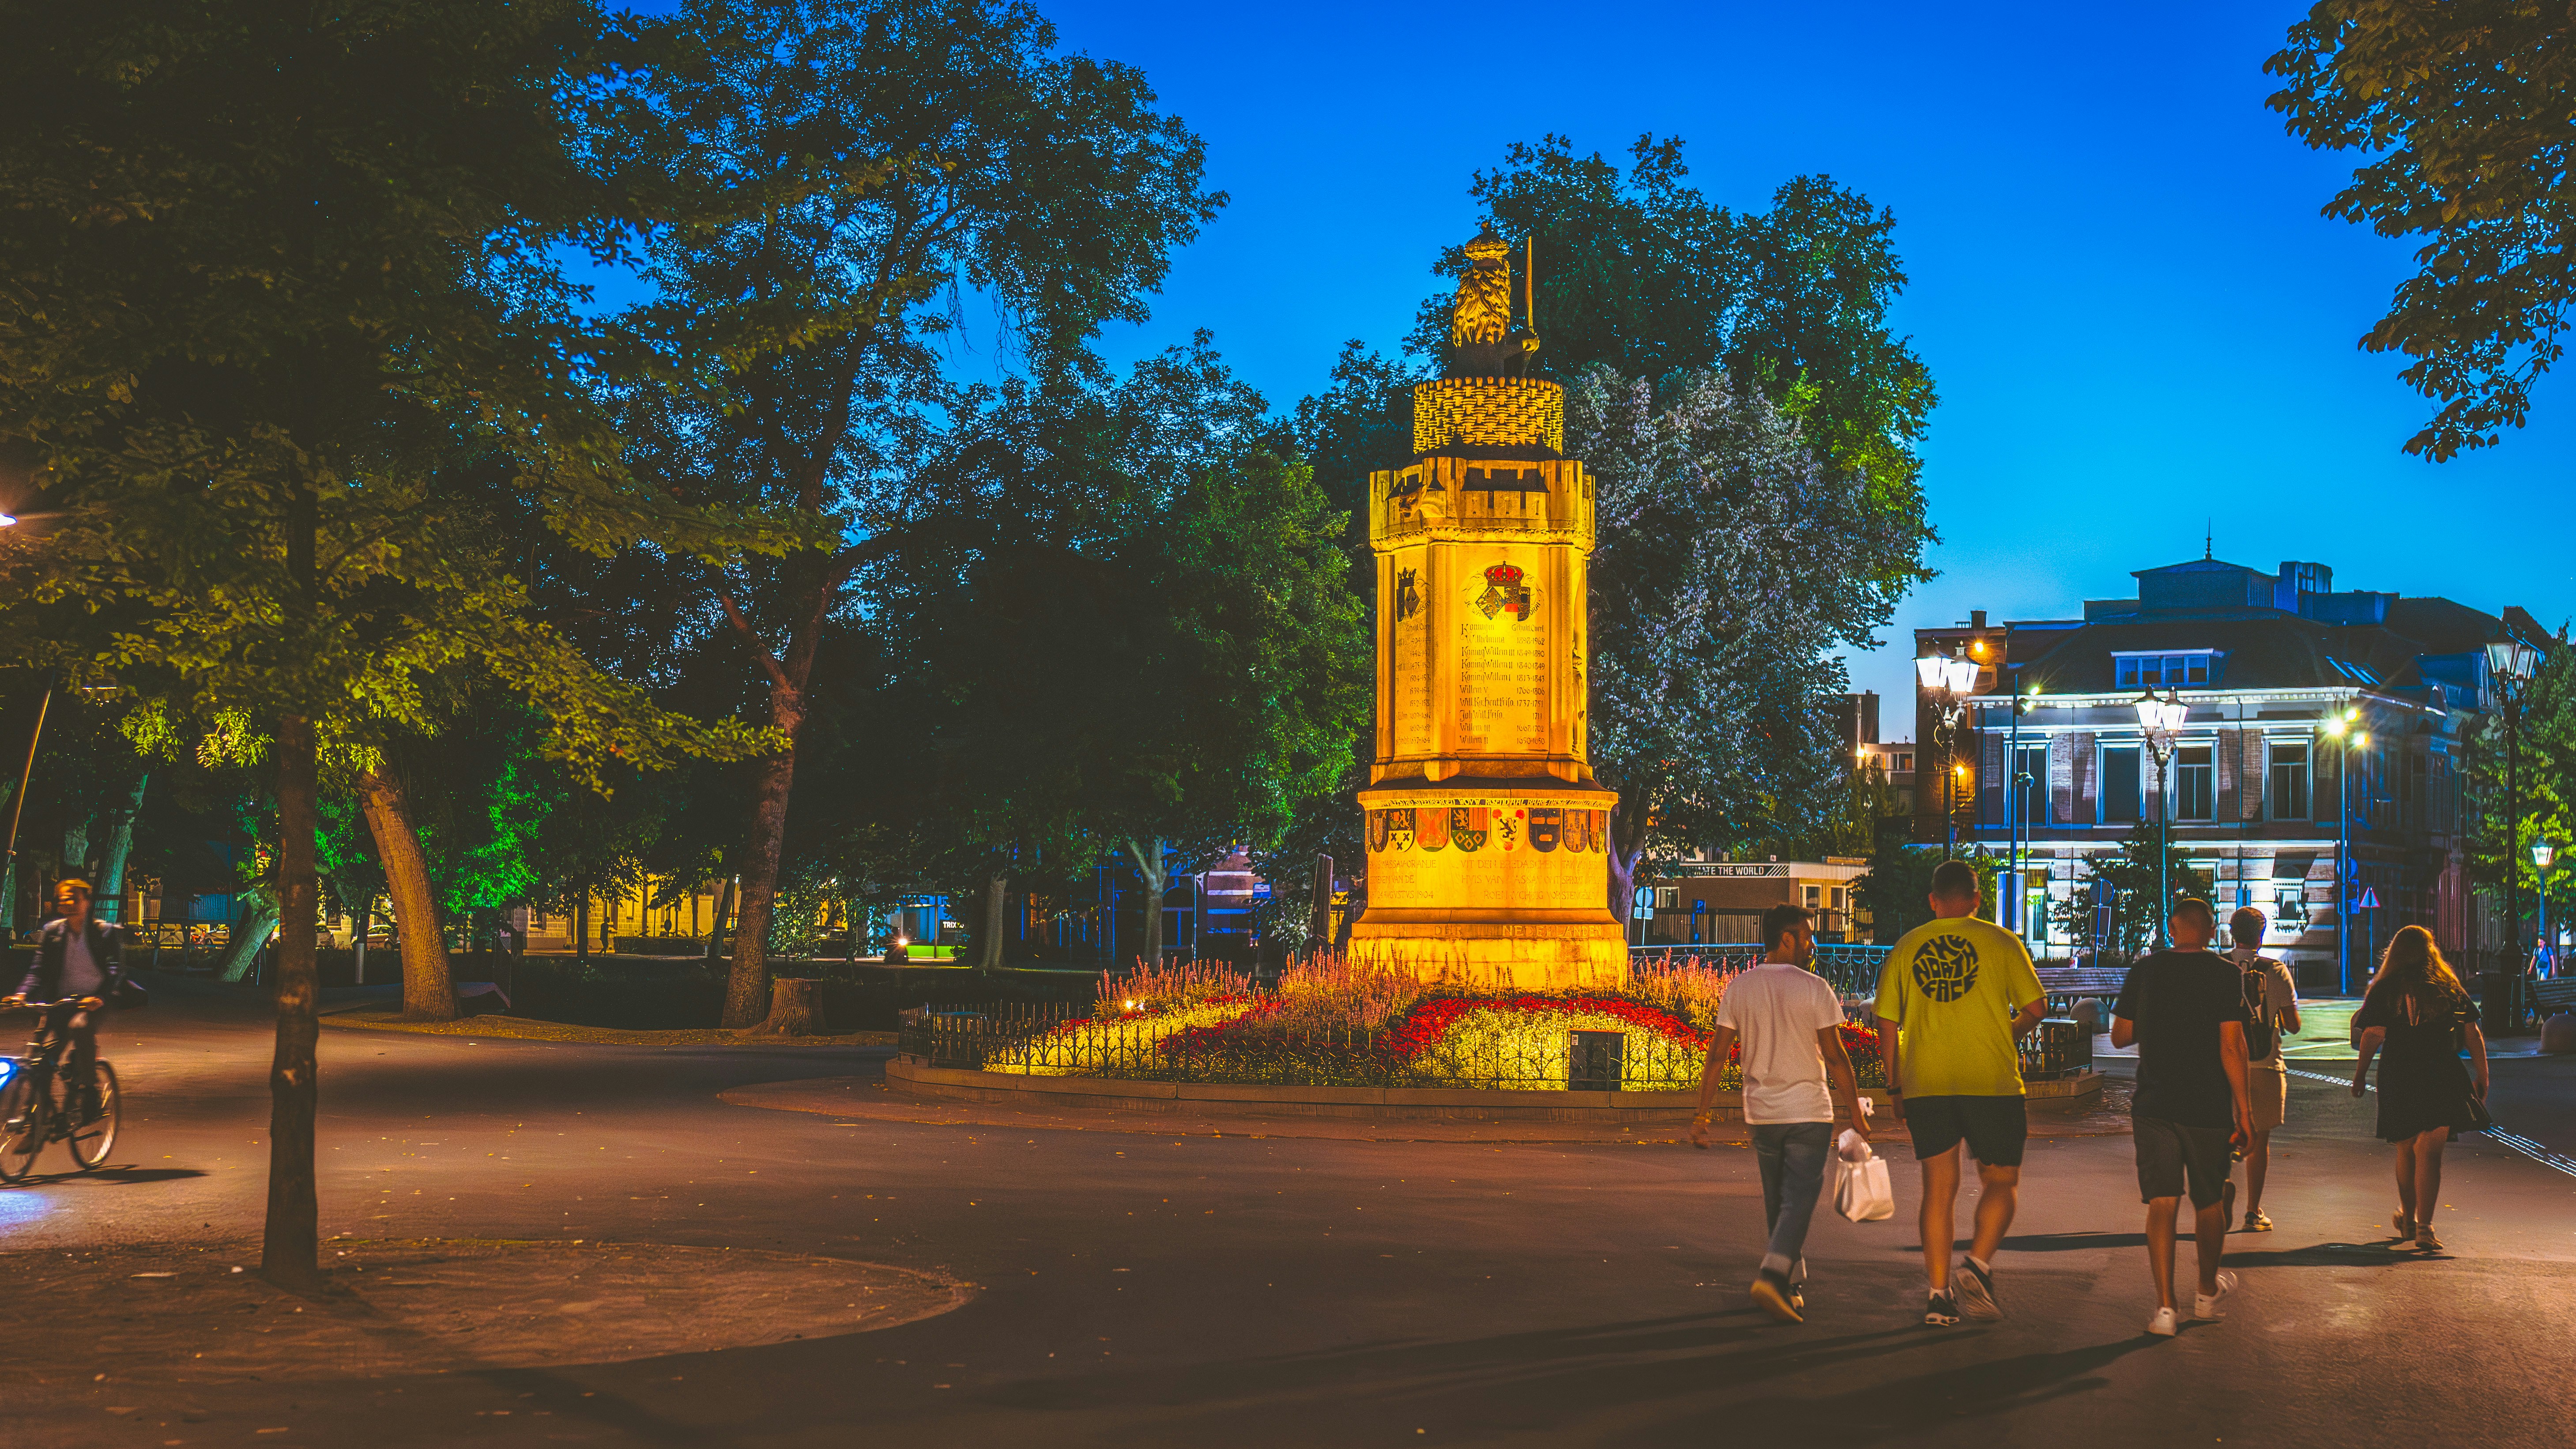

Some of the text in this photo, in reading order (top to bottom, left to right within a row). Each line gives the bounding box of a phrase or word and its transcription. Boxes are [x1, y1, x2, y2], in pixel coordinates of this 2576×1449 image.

[1517, 637, 1545, 645] 1898-1962
[1517, 662, 1545, 670] 1840-1849
[1718, 866, 1733, 875] THE
[1736, 866, 1764, 875] WORLD
[1913, 934, 1967, 963] THE
[1912, 941, 1978, 987] NORTH
[1921, 965, 1979, 1002] FACE
